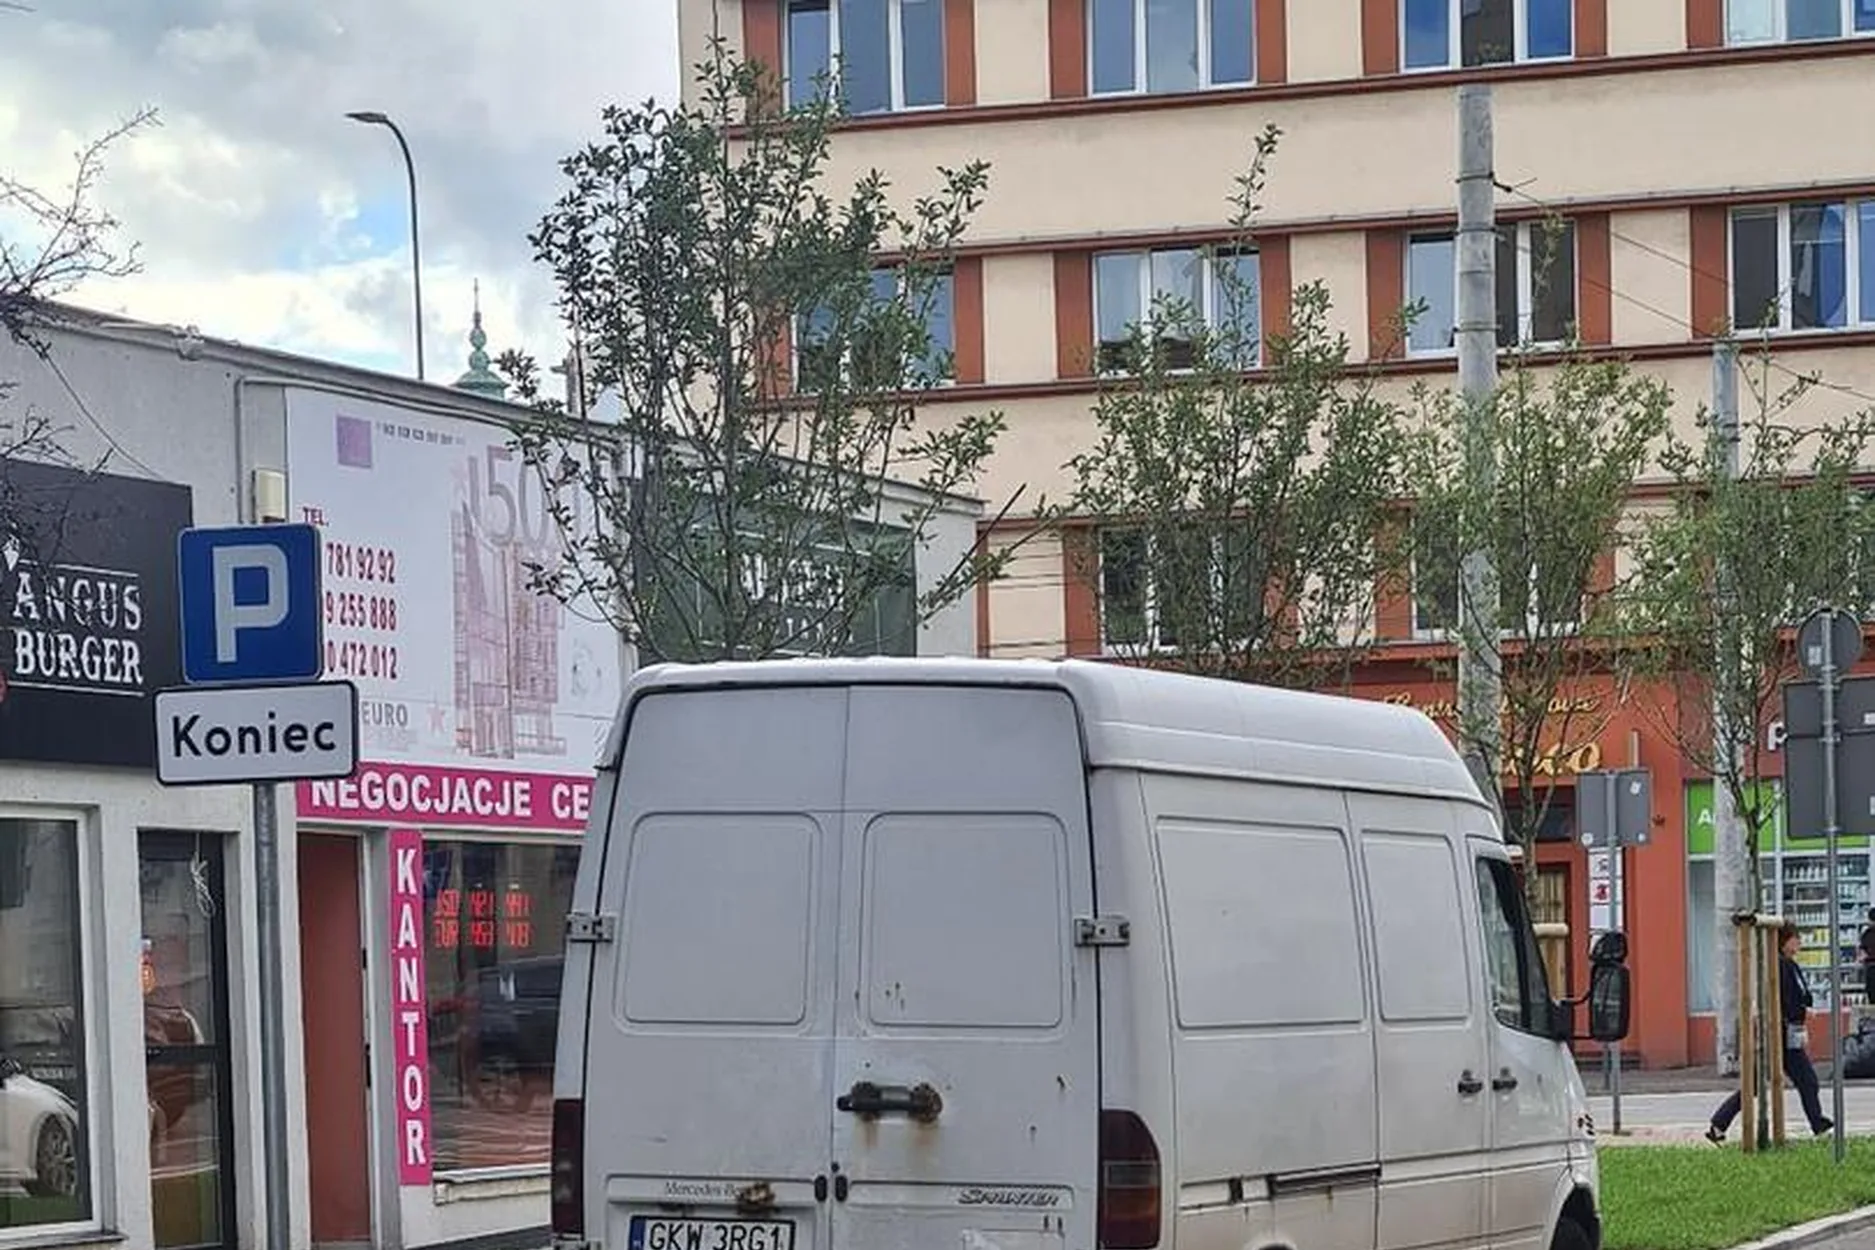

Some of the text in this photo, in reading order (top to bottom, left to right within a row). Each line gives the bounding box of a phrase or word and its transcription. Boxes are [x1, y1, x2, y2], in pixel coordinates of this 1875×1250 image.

[302, 506, 329, 527] TEL.
[326, 541, 395, 584] 781 92 92
[13, 572, 141, 631] ANGUS
[212, 543, 289, 664] P
[339, 592, 366, 627] 255
[370, 596, 396, 631] 888
[14, 629, 143, 686] BURGER
[340, 641, 366, 677] 472
[371, 645, 397, 680] 012
[172, 711, 337, 758] Koniec
[361, 701, 409, 728] EURO
[311, 770, 532, 817] NEGOCJACJE
[396, 848, 427, 1167] KANTOR
